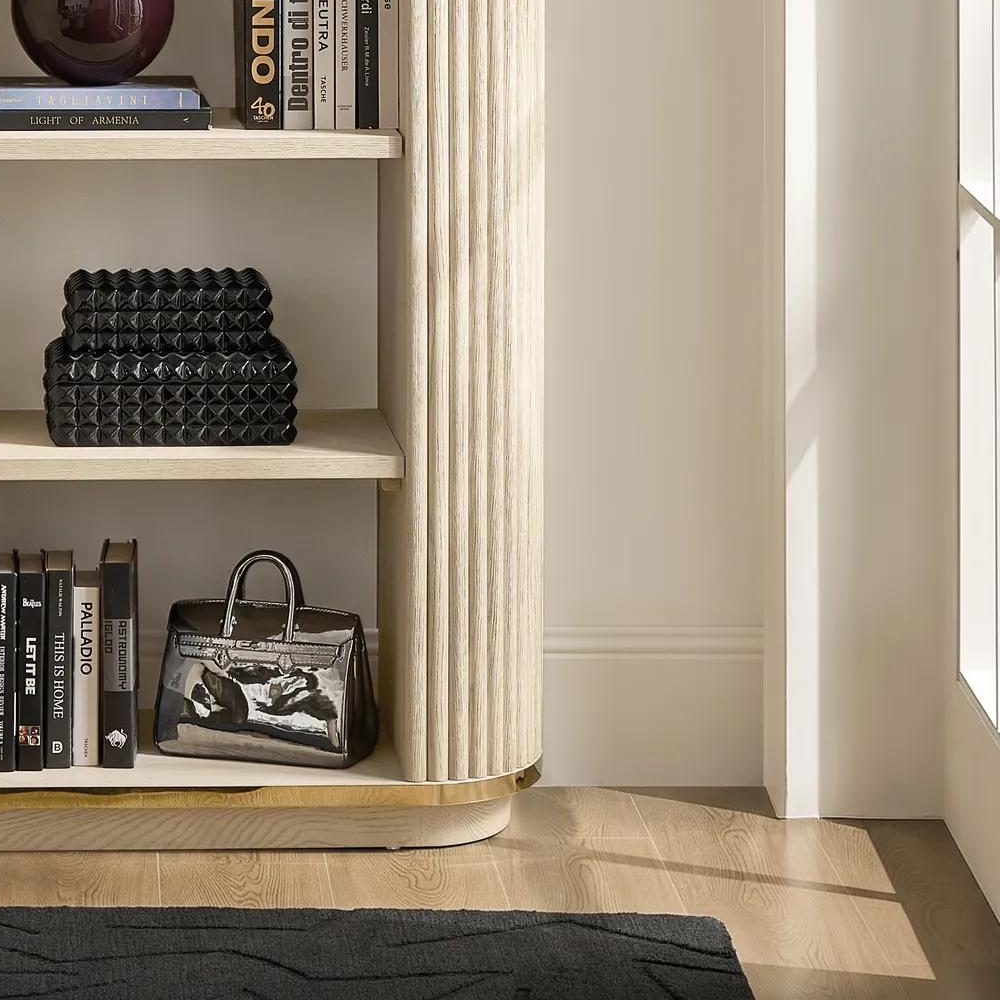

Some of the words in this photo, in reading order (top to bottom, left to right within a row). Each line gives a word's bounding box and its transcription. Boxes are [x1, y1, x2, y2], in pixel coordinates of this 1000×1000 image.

[287, 11, 309, 30] di
[287, 37, 309, 111] Dentro
[36, 95, 148, 105] TAGLIAVINI
[250, 96, 276, 117] 40
[30, 116, 62, 125] LIGHT
[69, 116, 84, 125] OF
[91, 116, 140, 125] ARMENIA
[53, 632, 65, 661] THIS
[80, 602, 93, 676] PALLADIO
[104, 620, 113, 654] IGLOO
[25, 637, 37, 661] LET
[118, 621, 127, 689] ASTRONOMY
[25, 662, 37, 676] IT
[53, 665, 64, 676] IS
[25, 678, 37, 696] BE
[53, 680, 64, 718] HOME
